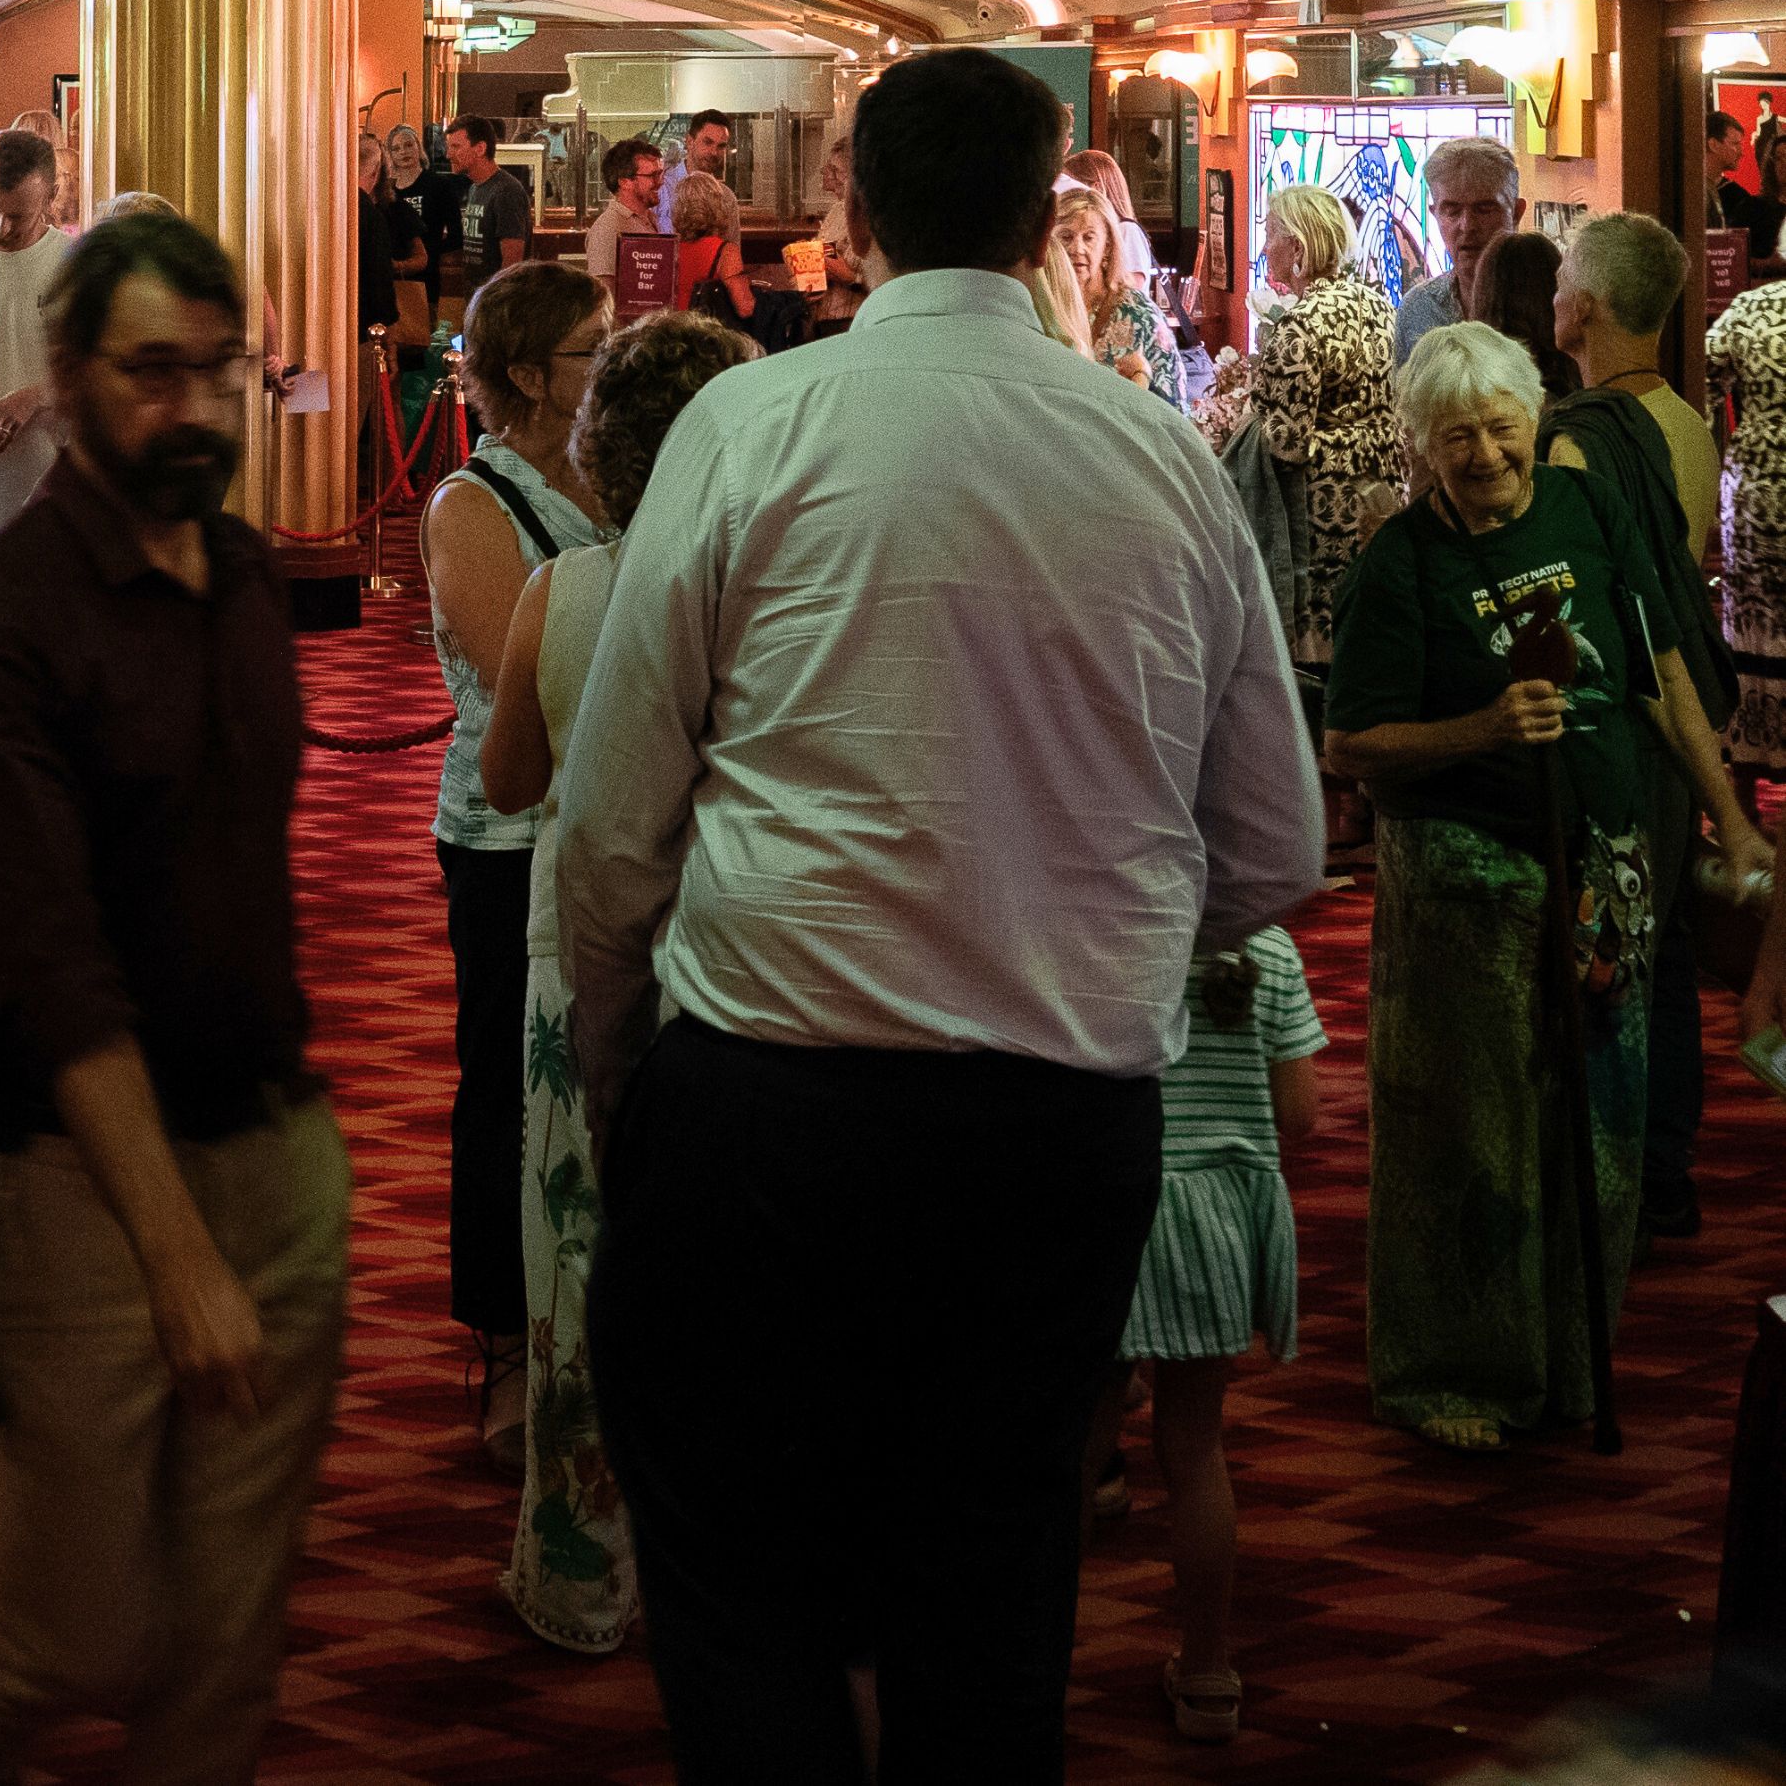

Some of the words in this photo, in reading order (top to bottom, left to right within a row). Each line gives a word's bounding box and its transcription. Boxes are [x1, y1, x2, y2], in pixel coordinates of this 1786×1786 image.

[631, 251, 663, 260] Queue
[636, 261, 658, 270] here
[639, 271, 654, 279] for
[637, 281, 654, 290] Bar
[1472, 573, 1530, 601] PRTECT
[1529, 561, 1570, 581] NATIVE
